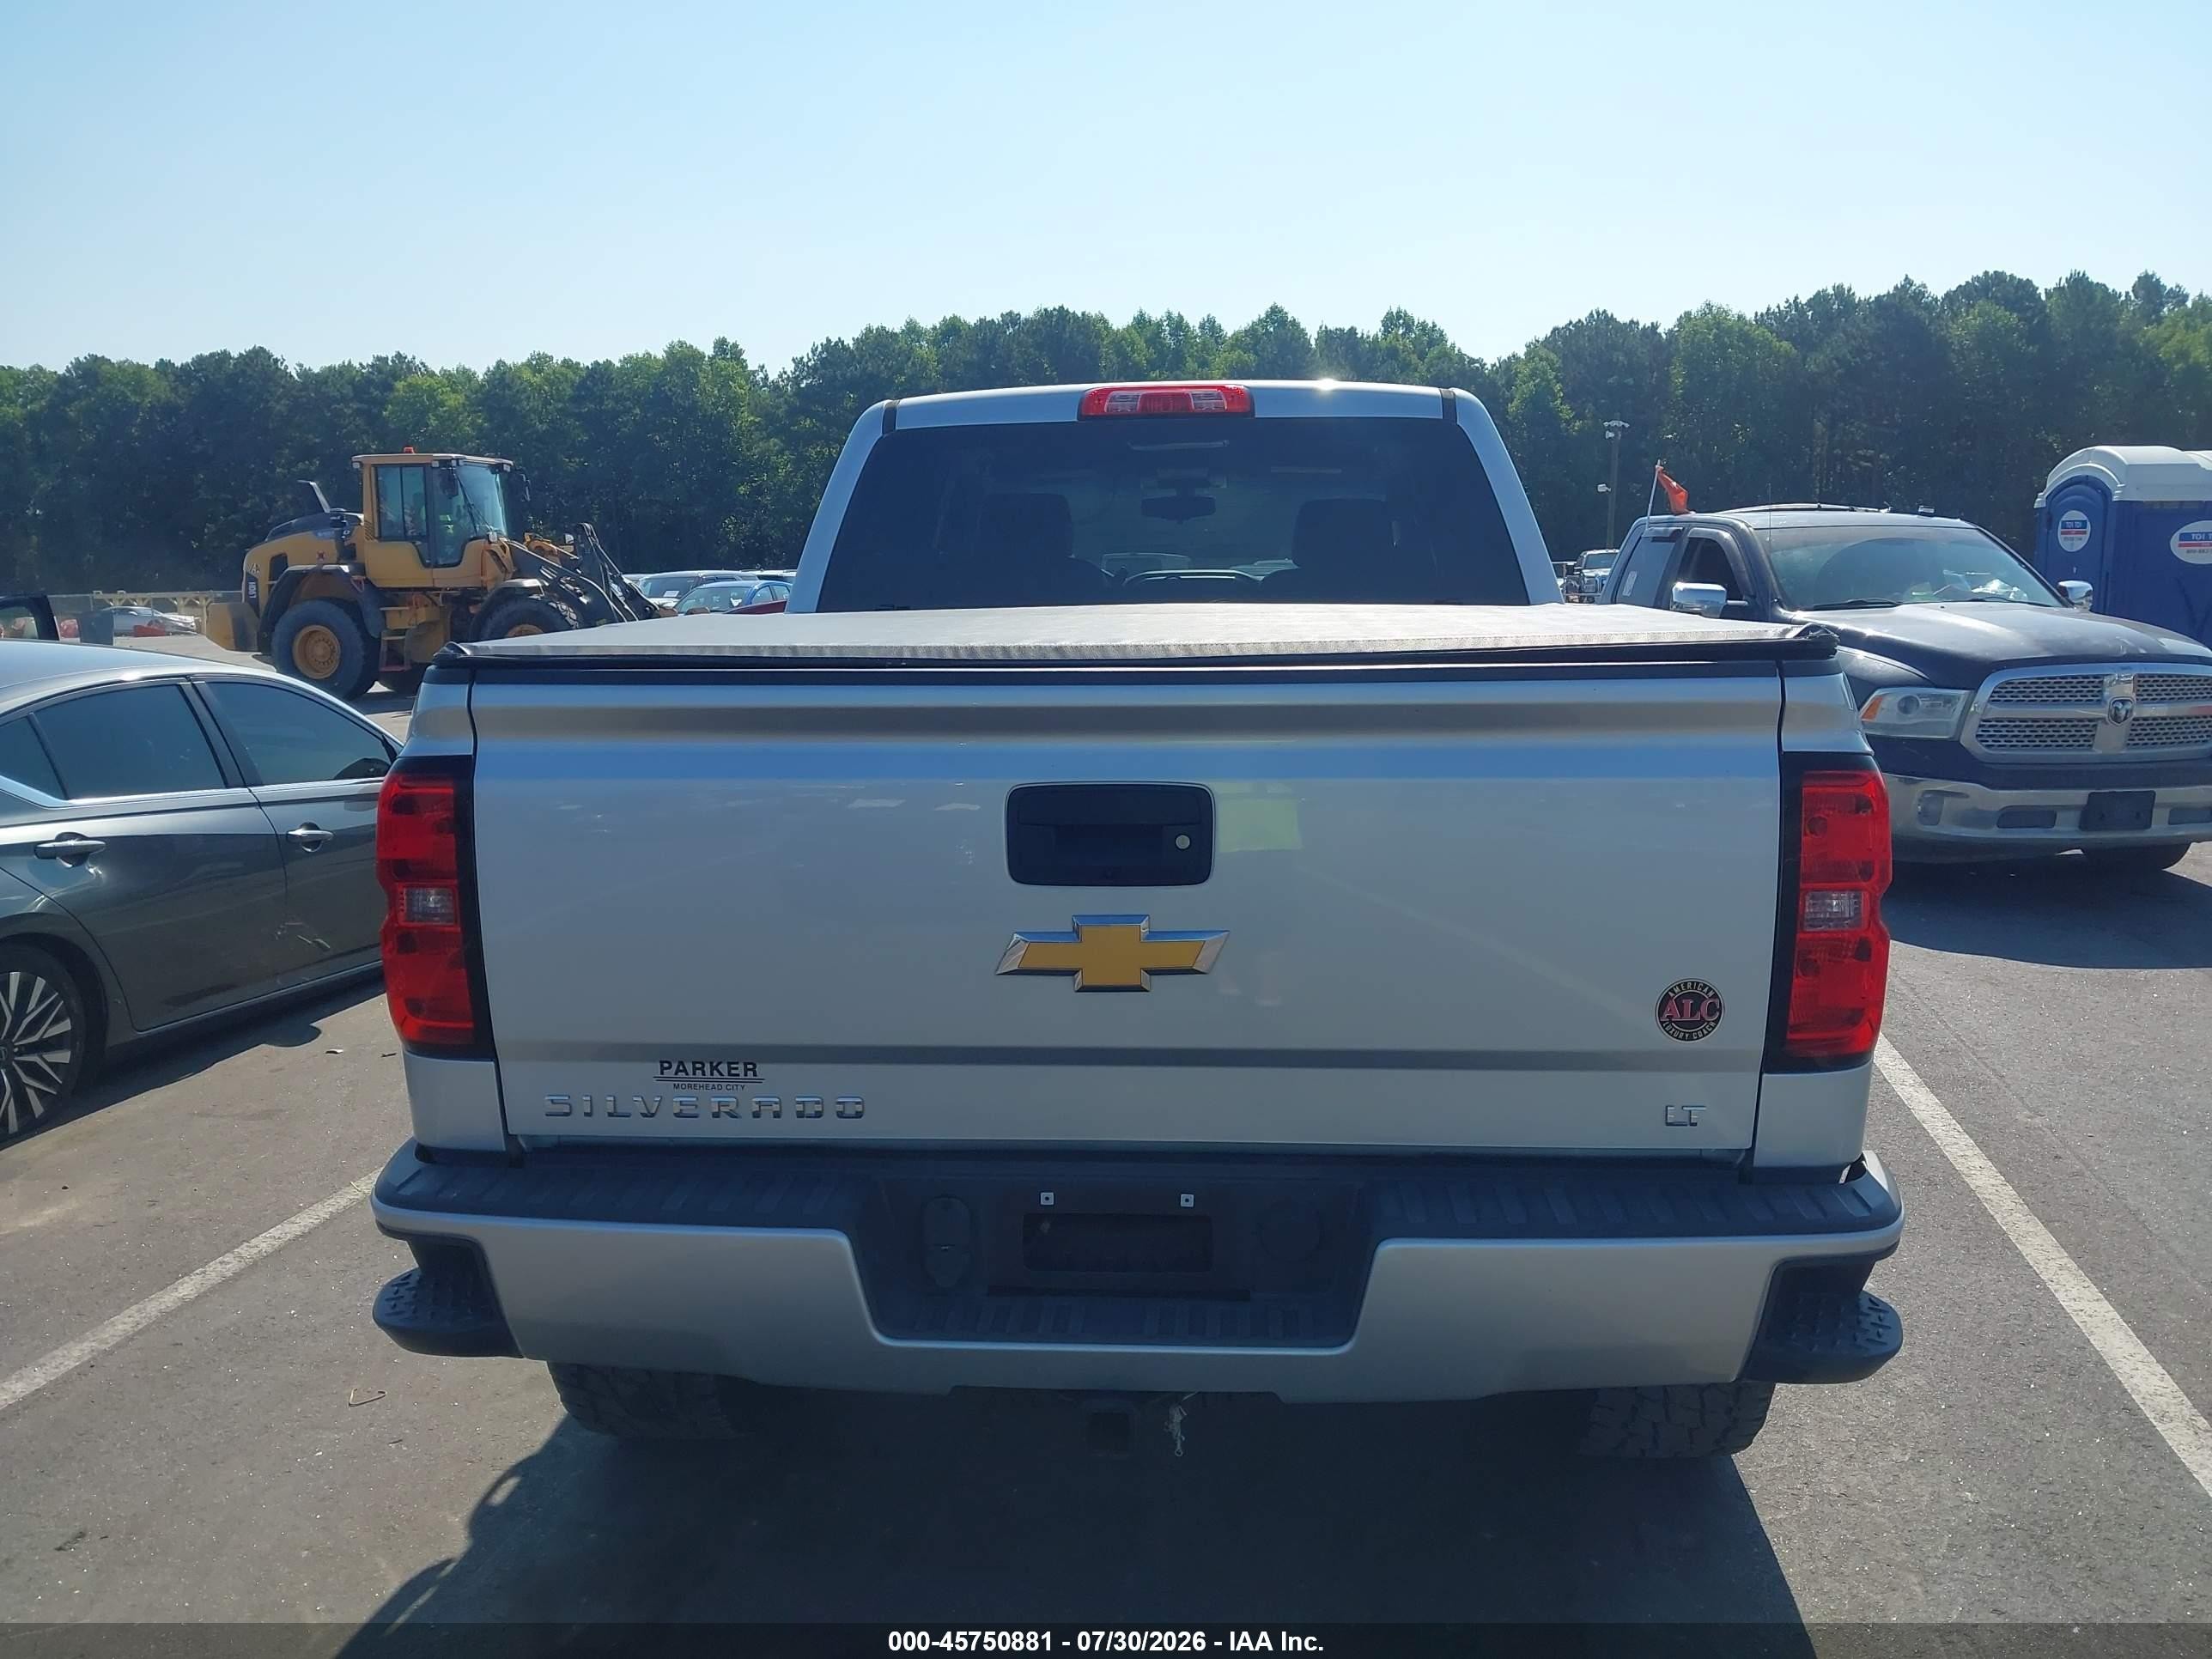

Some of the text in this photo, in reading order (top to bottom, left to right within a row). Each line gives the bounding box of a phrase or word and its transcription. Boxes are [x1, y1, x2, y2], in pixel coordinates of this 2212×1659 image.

[1668, 982, 1716, 997] AMERICAN
[1660, 998, 1720, 1021] ALC
[1662, 1022, 1717, 1040] LUXURY COACH
[659, 1060, 757, 1077] PARKER
[544, 1094, 866, 1119] SILVERADO
[1665, 1105, 1707, 1126] LT
